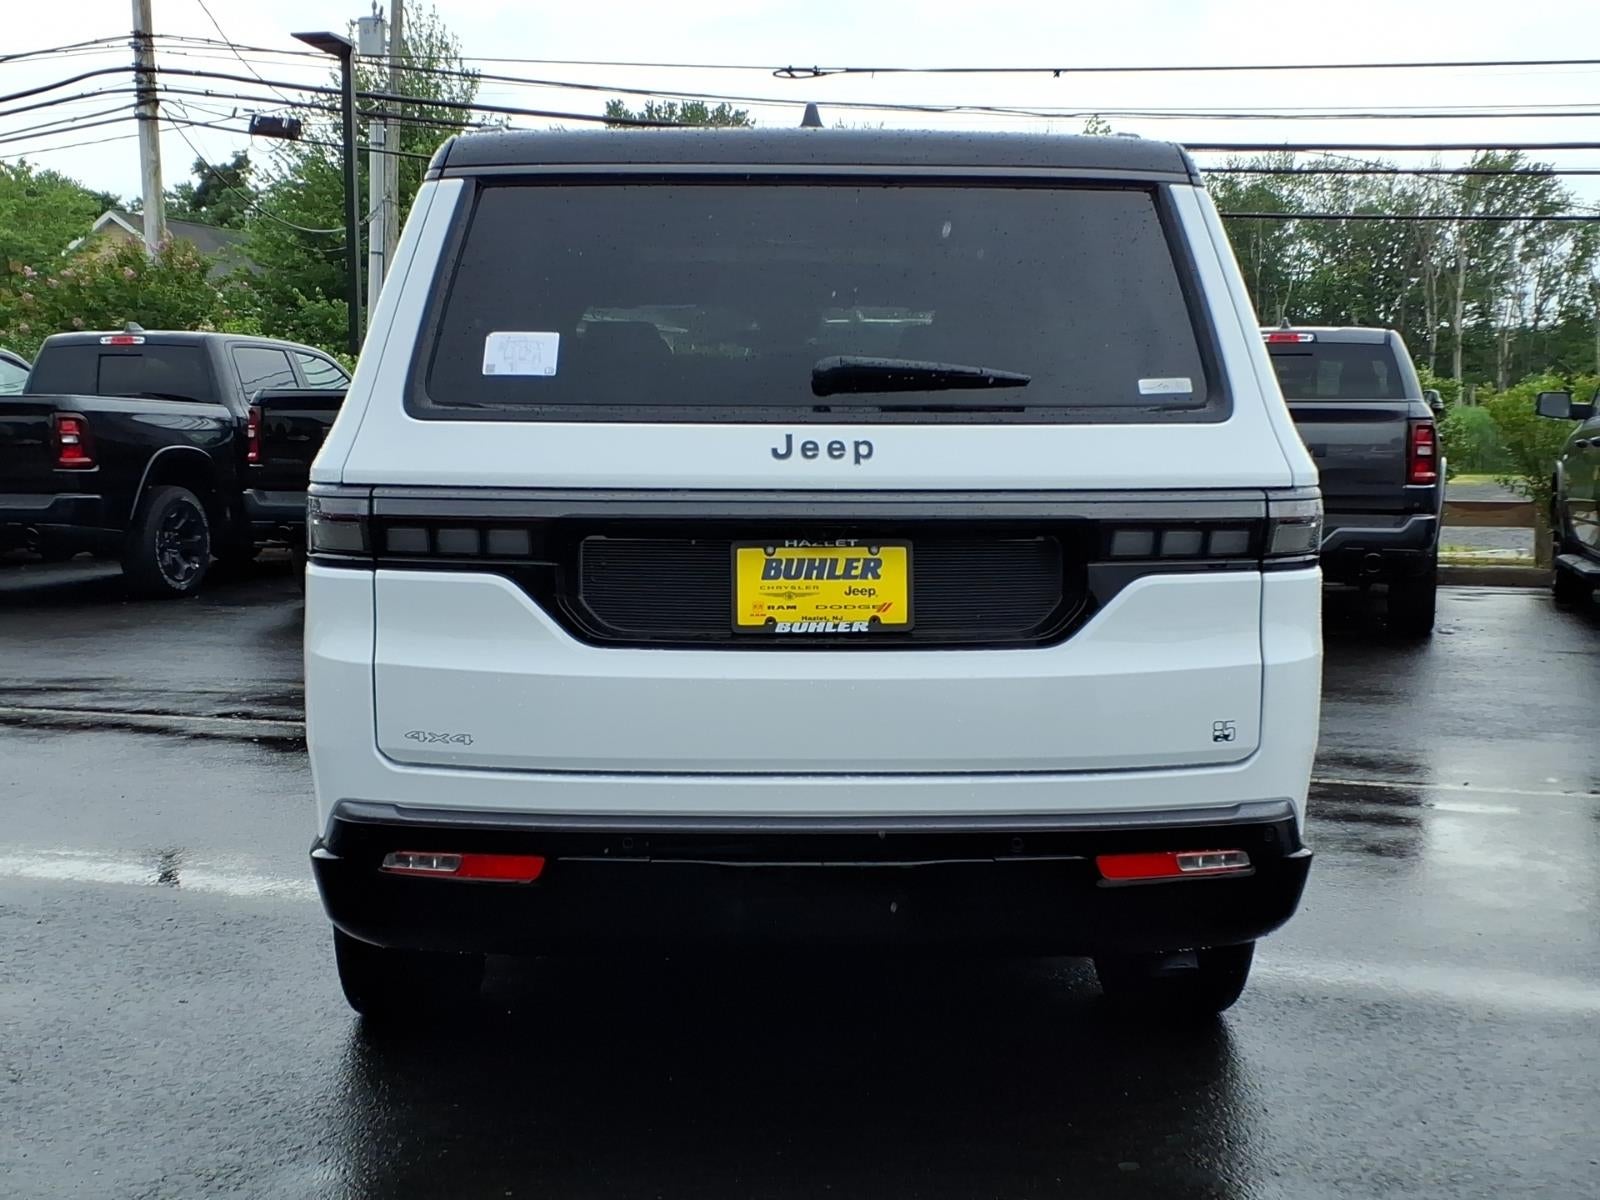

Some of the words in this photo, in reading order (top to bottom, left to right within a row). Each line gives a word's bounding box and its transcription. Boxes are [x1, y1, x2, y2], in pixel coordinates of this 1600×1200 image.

[771, 433, 874, 465] Jeep
[761, 558, 882, 580] BUHLER
[844, 585, 876, 597] Jeep
[775, 621, 869, 633] BUHLER
